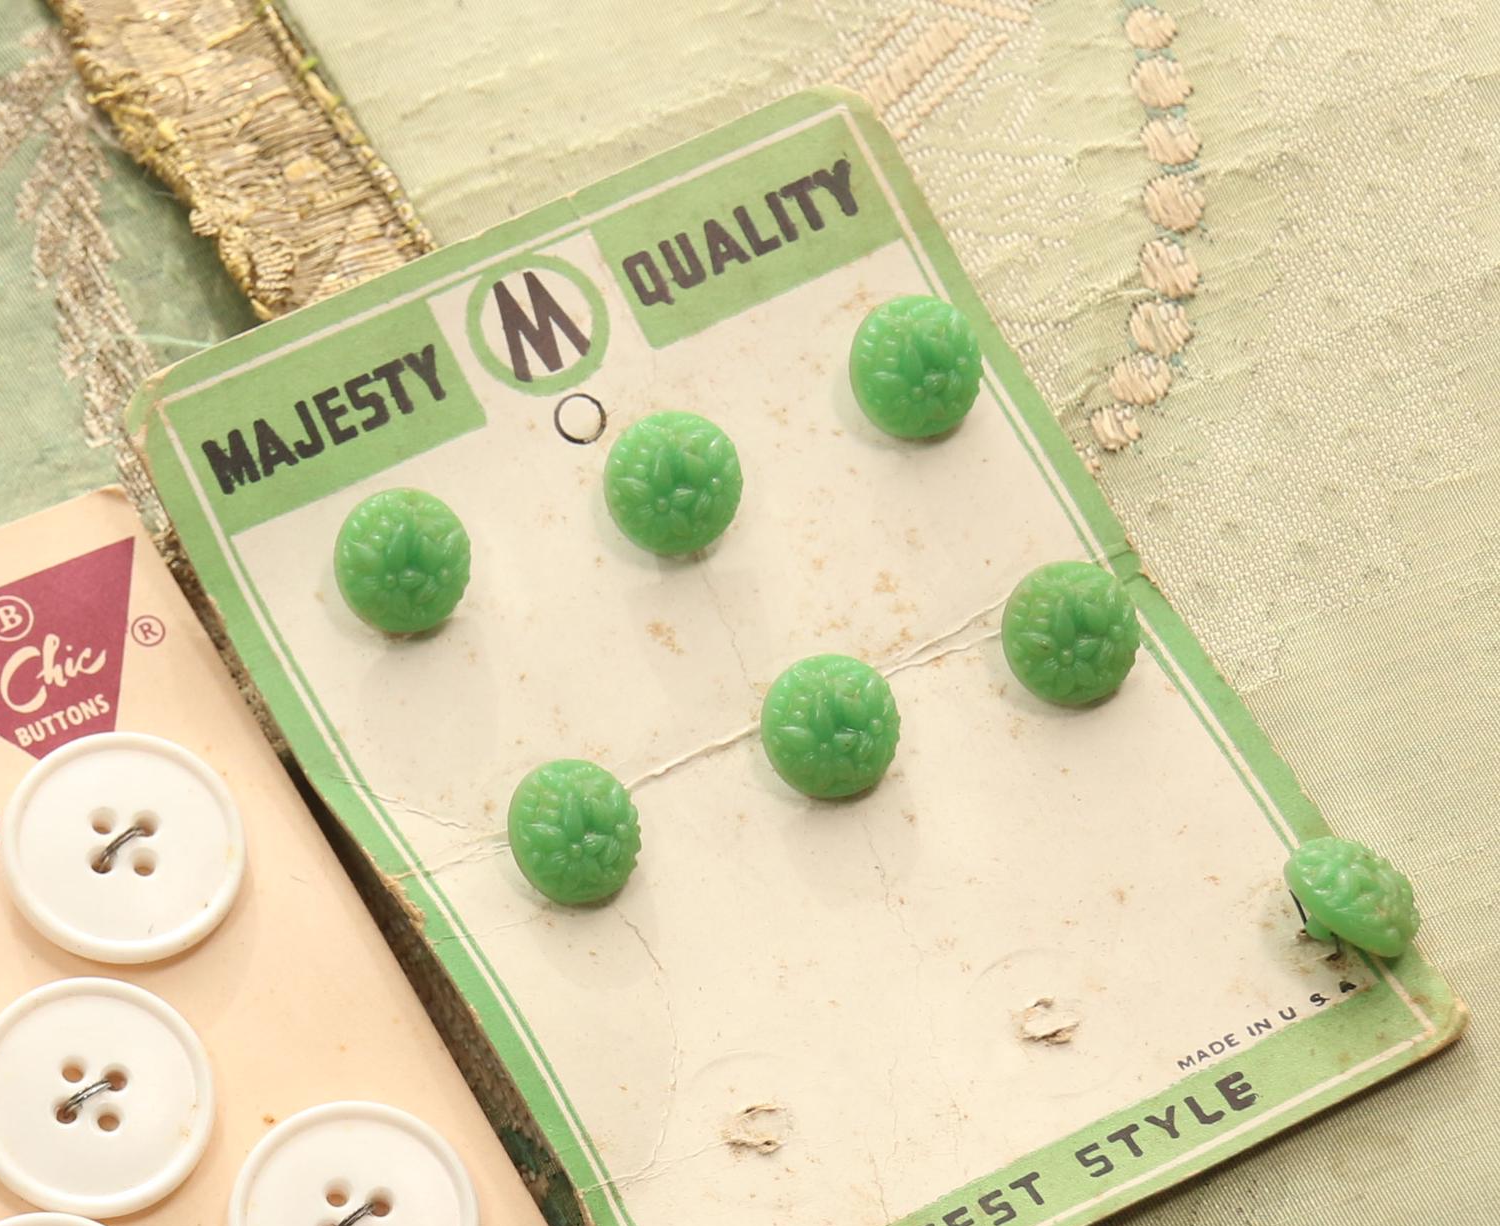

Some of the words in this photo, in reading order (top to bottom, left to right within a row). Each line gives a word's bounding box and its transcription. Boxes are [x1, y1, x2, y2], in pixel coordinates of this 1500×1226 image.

[622, 159, 860, 306] QUALITY
[493, 271, 590, 382] M
[201, 344, 446, 495] MAJESTY
[0, 633, 106, 713] Chic
[15, 694, 110, 747] BUTTONS
[1177, 1033, 1240, 1070] MADE
[1246, 1018, 1272, 1037] IN
[1074, 1071, 1257, 1178] STYLE
